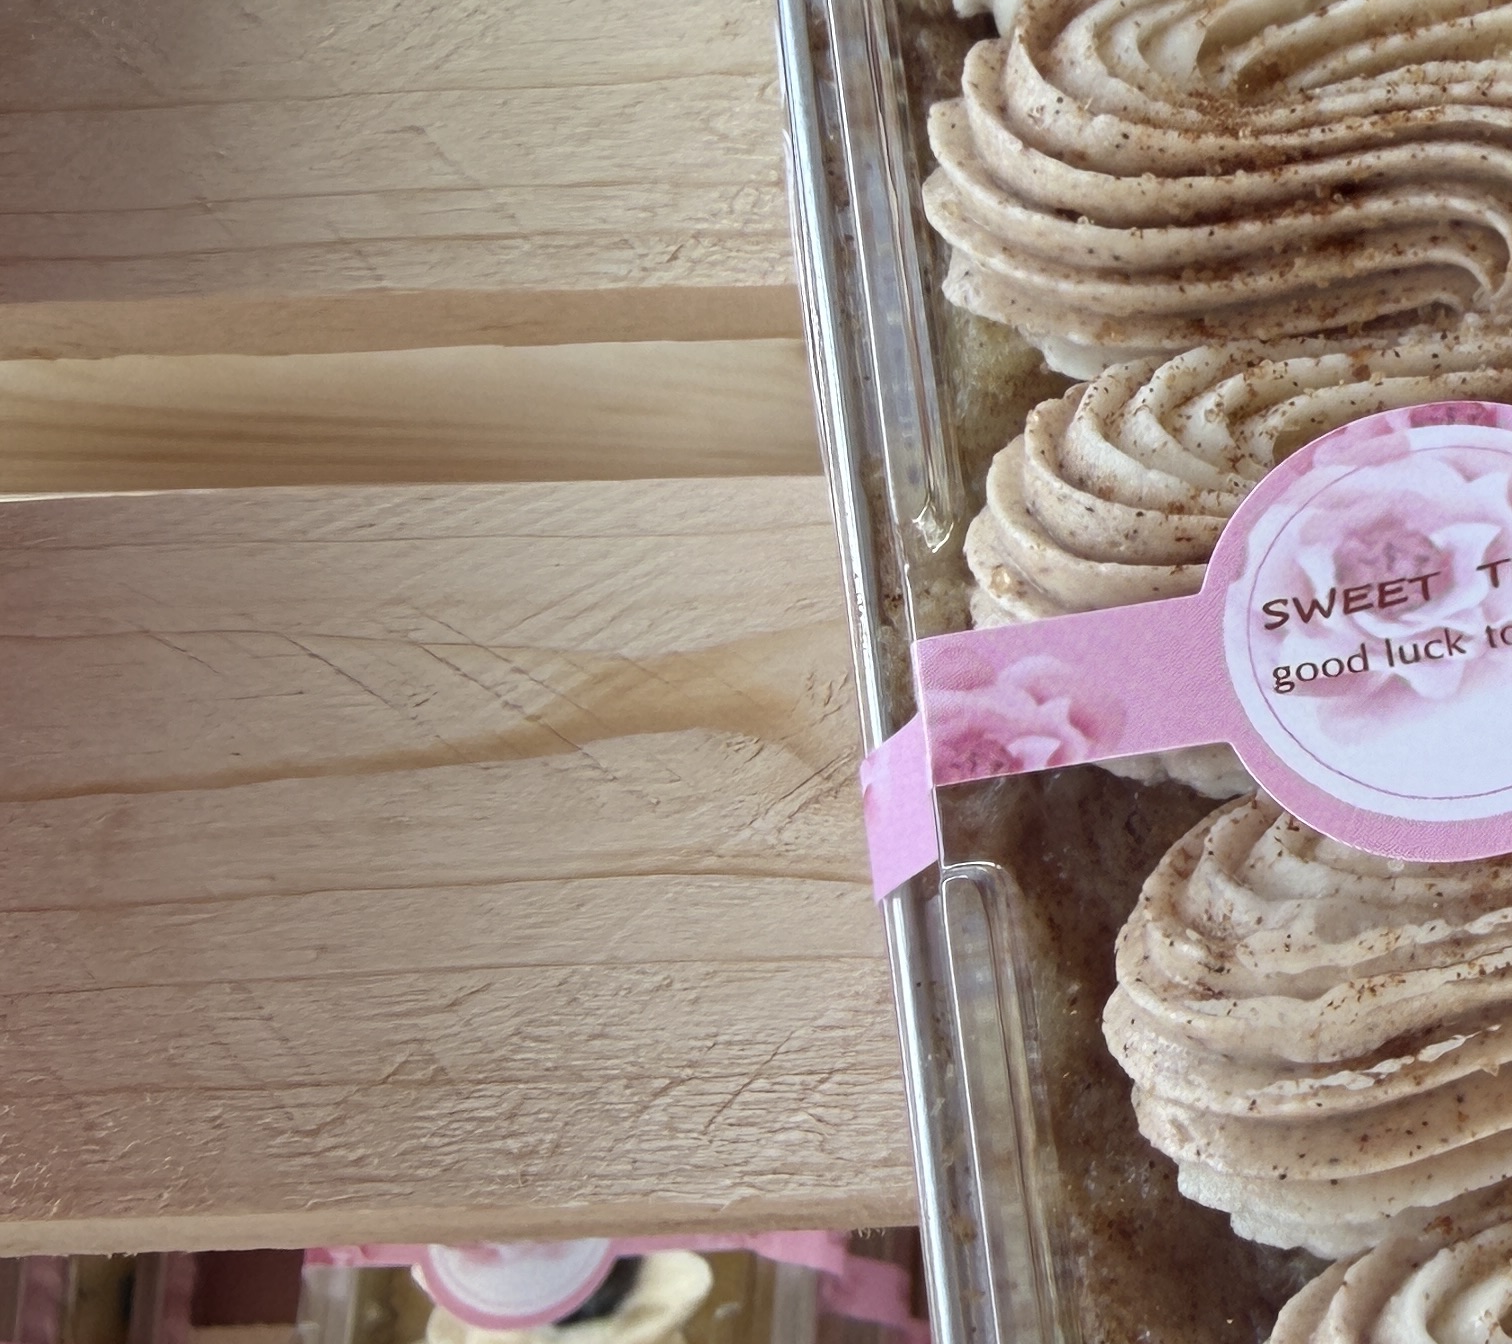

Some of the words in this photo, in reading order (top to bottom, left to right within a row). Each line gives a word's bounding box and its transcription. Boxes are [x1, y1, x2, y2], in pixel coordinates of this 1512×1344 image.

[1262, 571, 1441, 632] SWEET
[1271, 643, 1370, 694] good
[1385, 628, 1467, 669] luck
